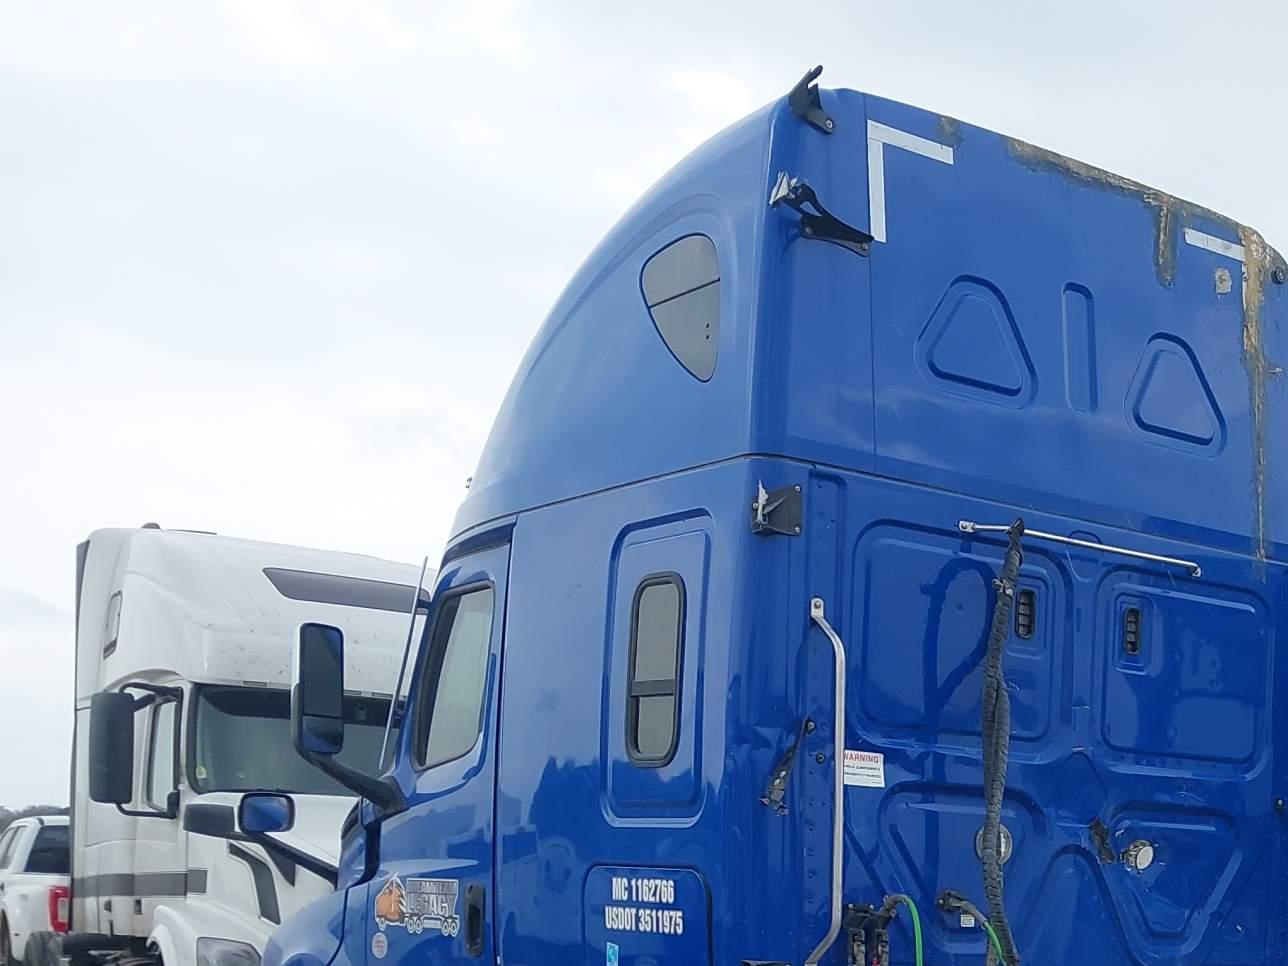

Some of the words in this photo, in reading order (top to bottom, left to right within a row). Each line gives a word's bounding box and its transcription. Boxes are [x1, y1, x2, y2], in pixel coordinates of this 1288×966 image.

[406, 892, 455, 916] LEGACY
[611, 877, 628, 901] MC
[631, 878, 675, 904] 1162766
[604, 905, 637, 931] USDOT
[638, 908, 683, 935] 3511975
